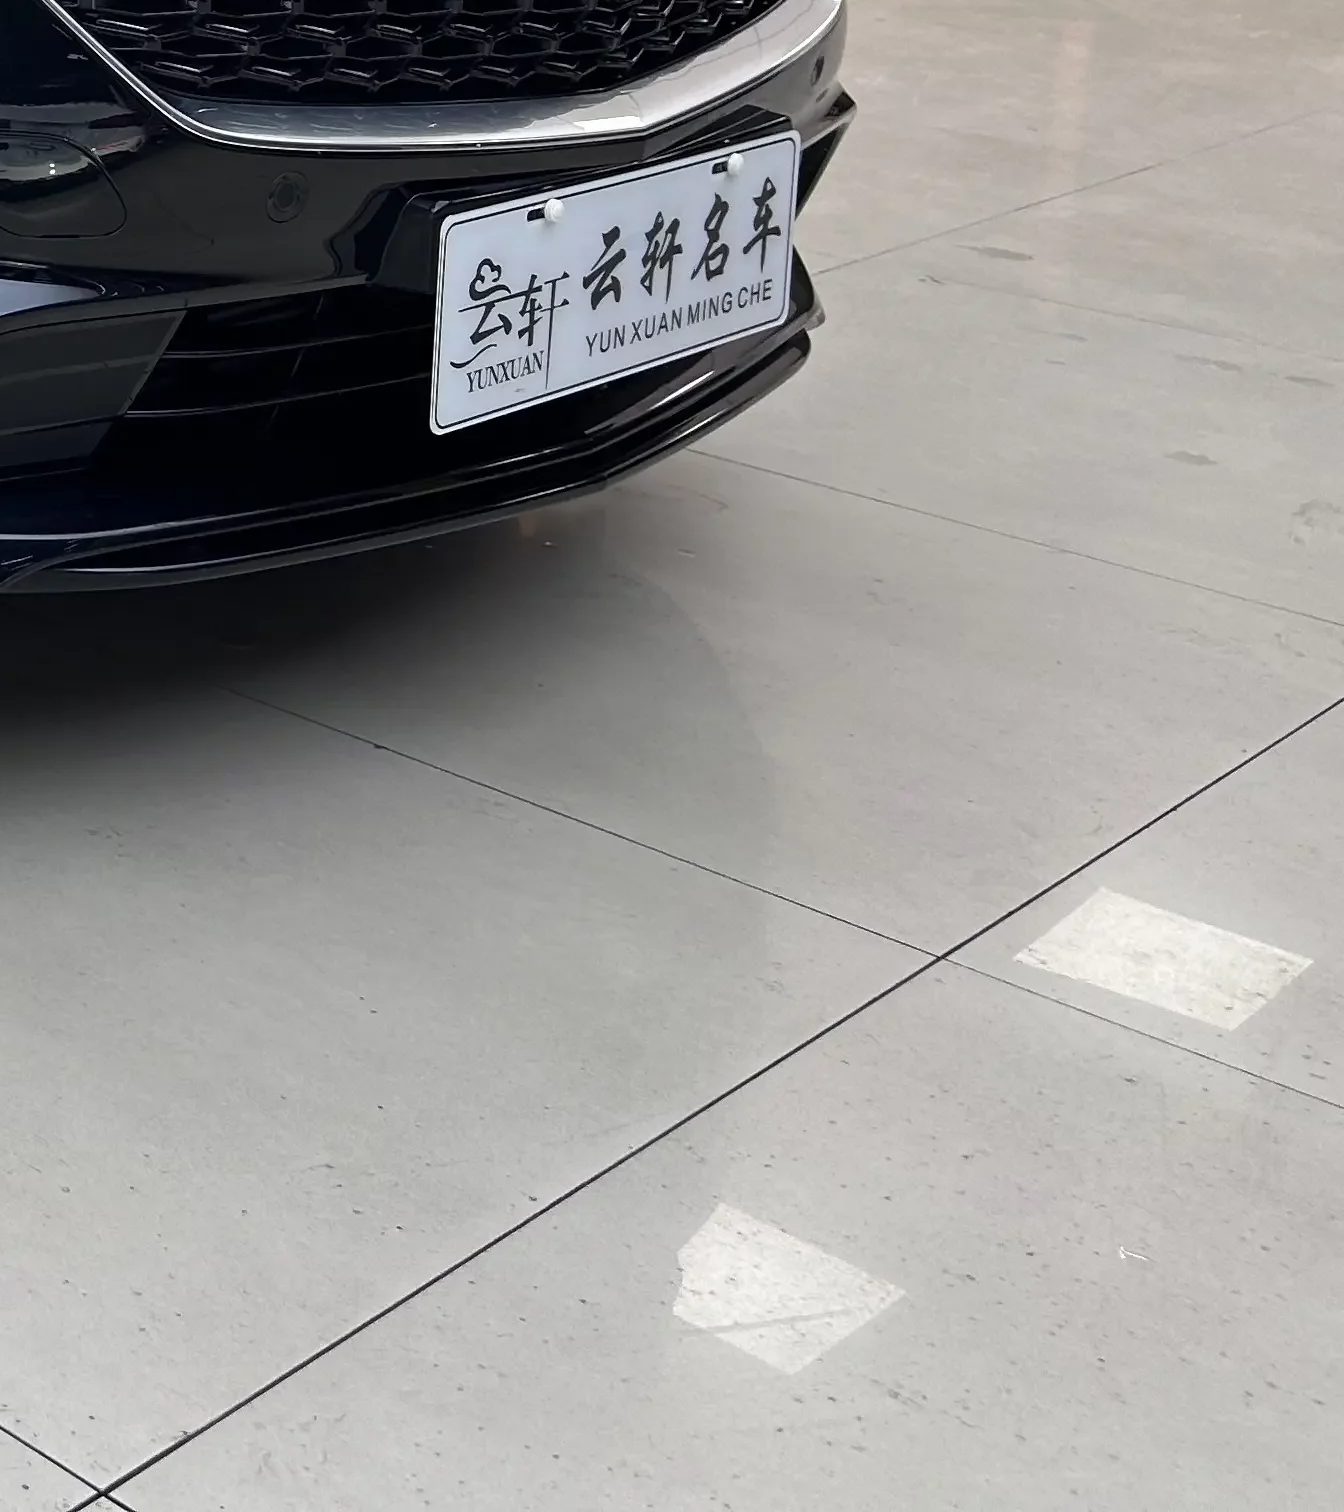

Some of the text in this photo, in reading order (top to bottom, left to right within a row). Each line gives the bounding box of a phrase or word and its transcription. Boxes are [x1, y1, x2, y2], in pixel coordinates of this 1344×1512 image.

[582, 176, 782, 310] 云轩名车
[585, 278, 773, 357] YUN XUAN MING CHE
[466, 350, 544, 393] YUNXUAN
